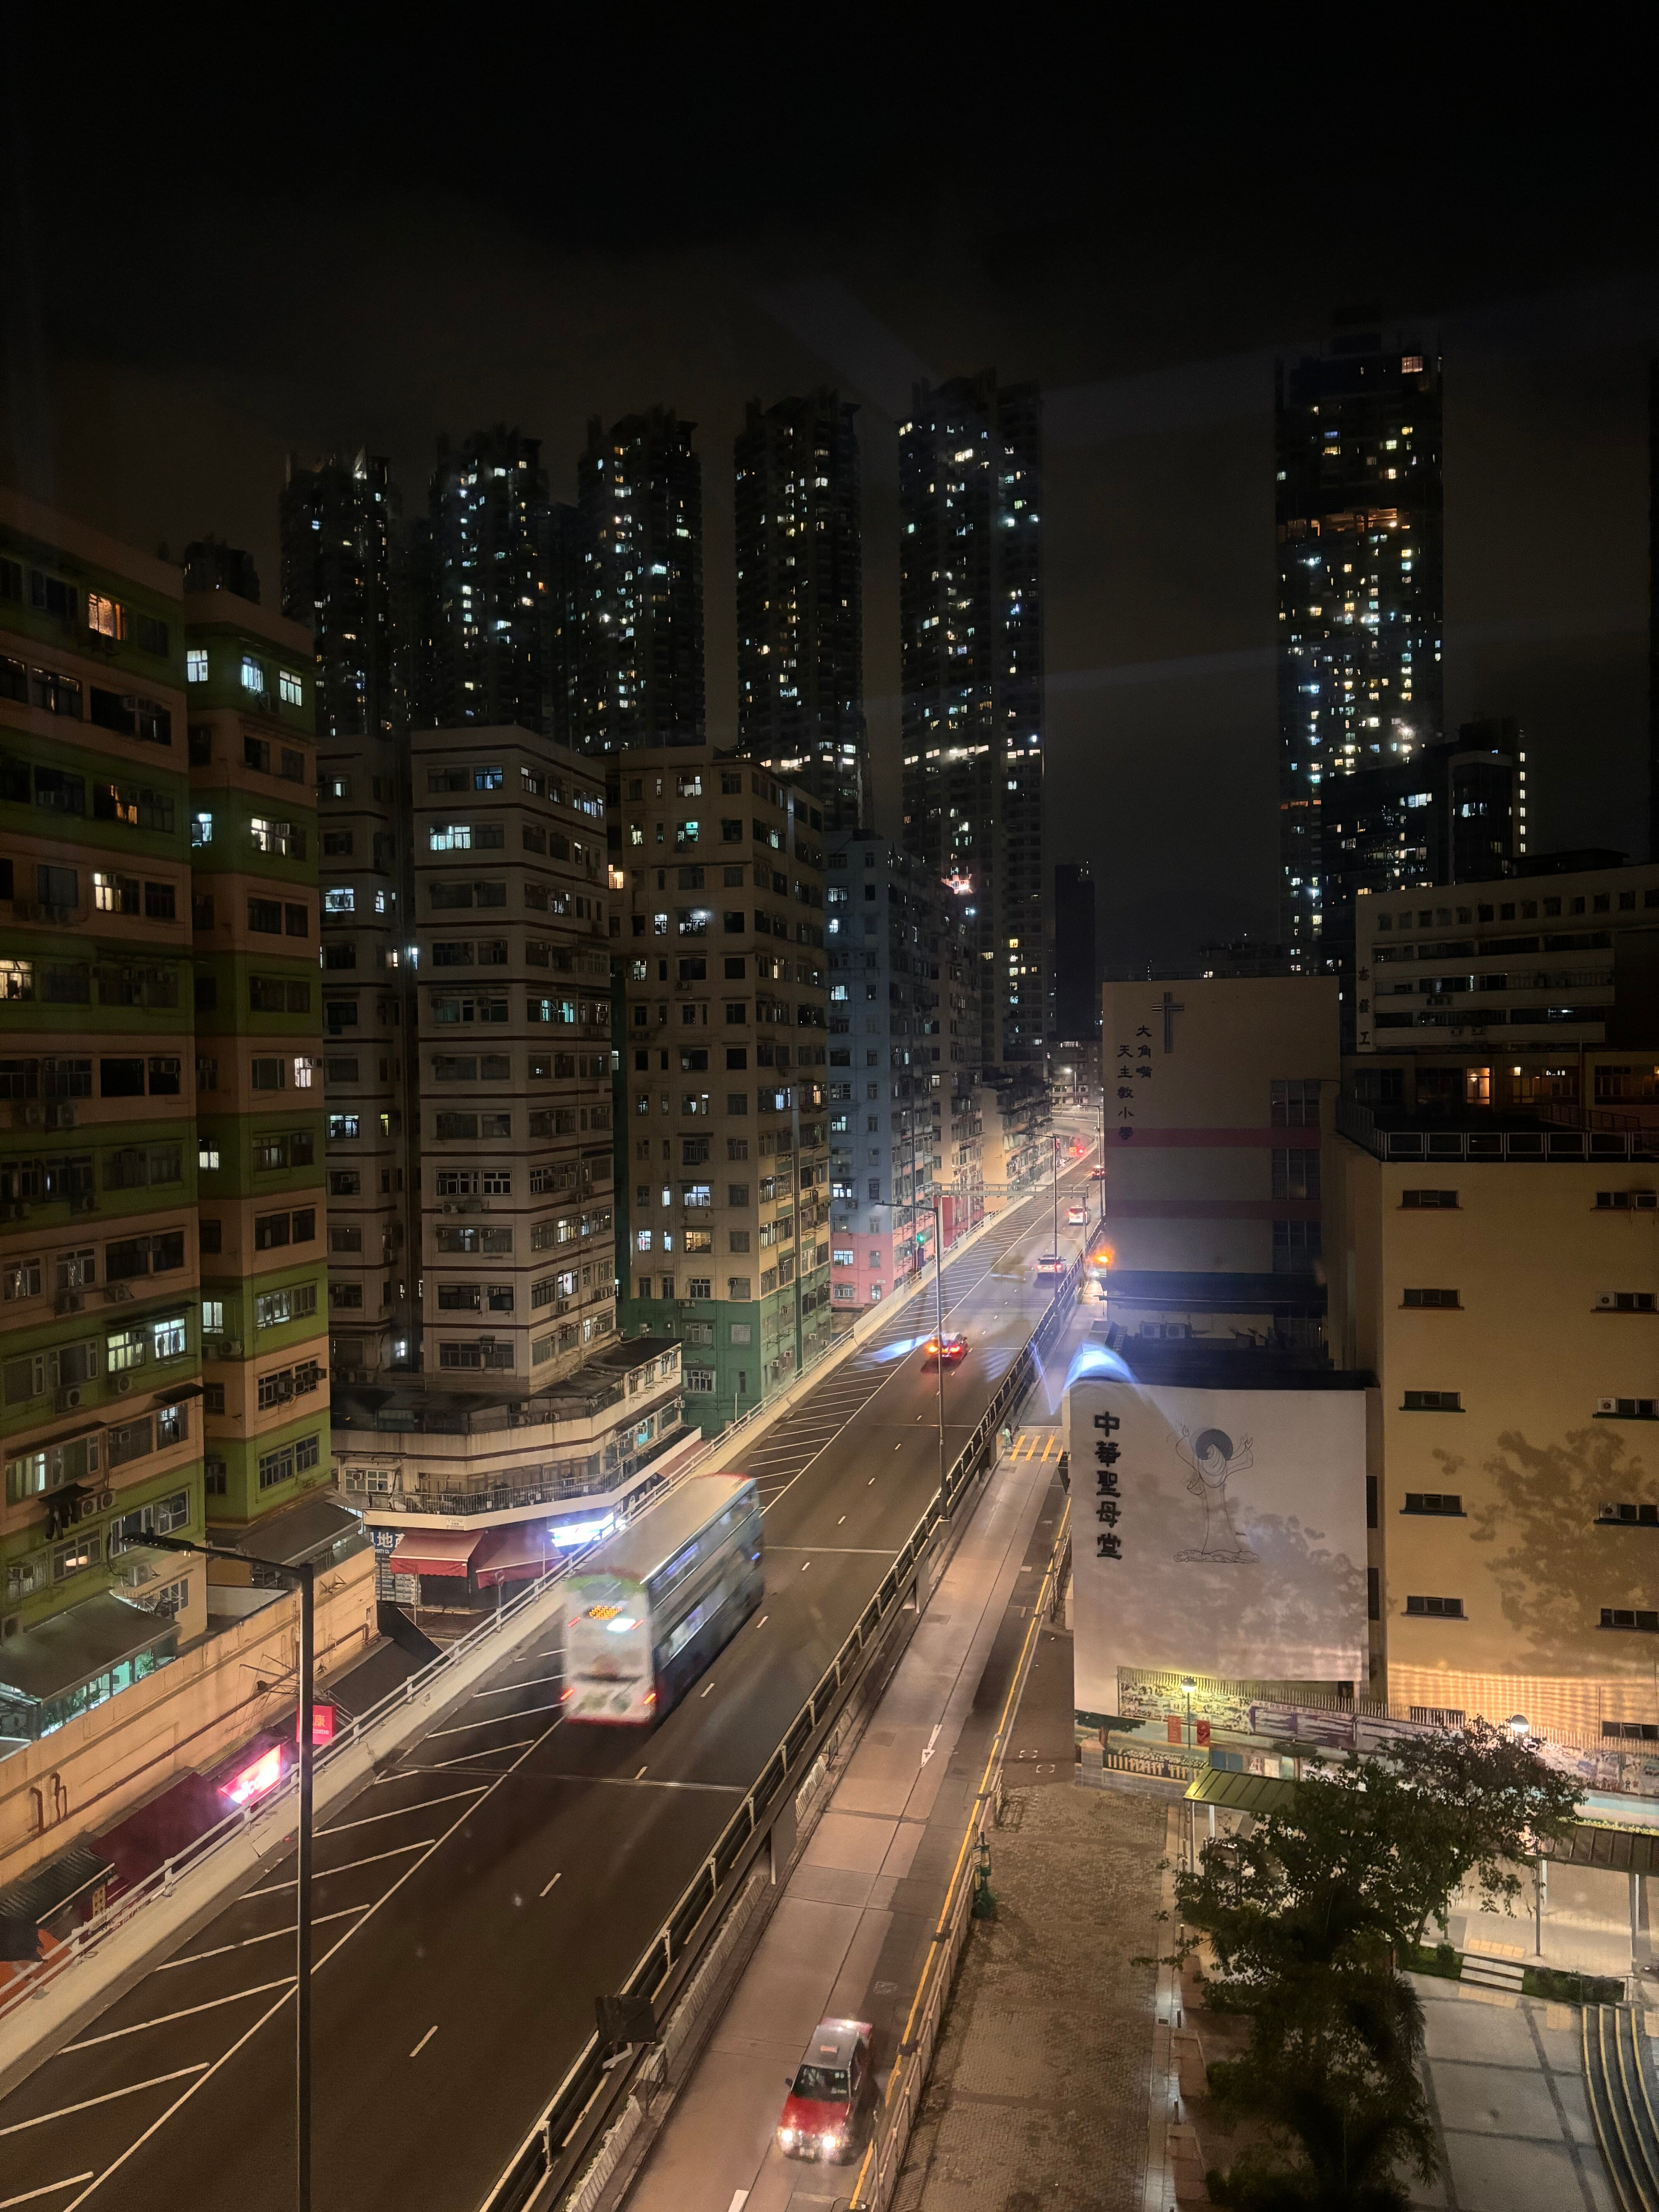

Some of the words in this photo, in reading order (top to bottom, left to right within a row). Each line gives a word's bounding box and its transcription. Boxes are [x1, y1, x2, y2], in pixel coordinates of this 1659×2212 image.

[1136, 1025, 1152, 1078] 大角嘴
[1094, 1411, 1122, 1560] 中華聖母堂
